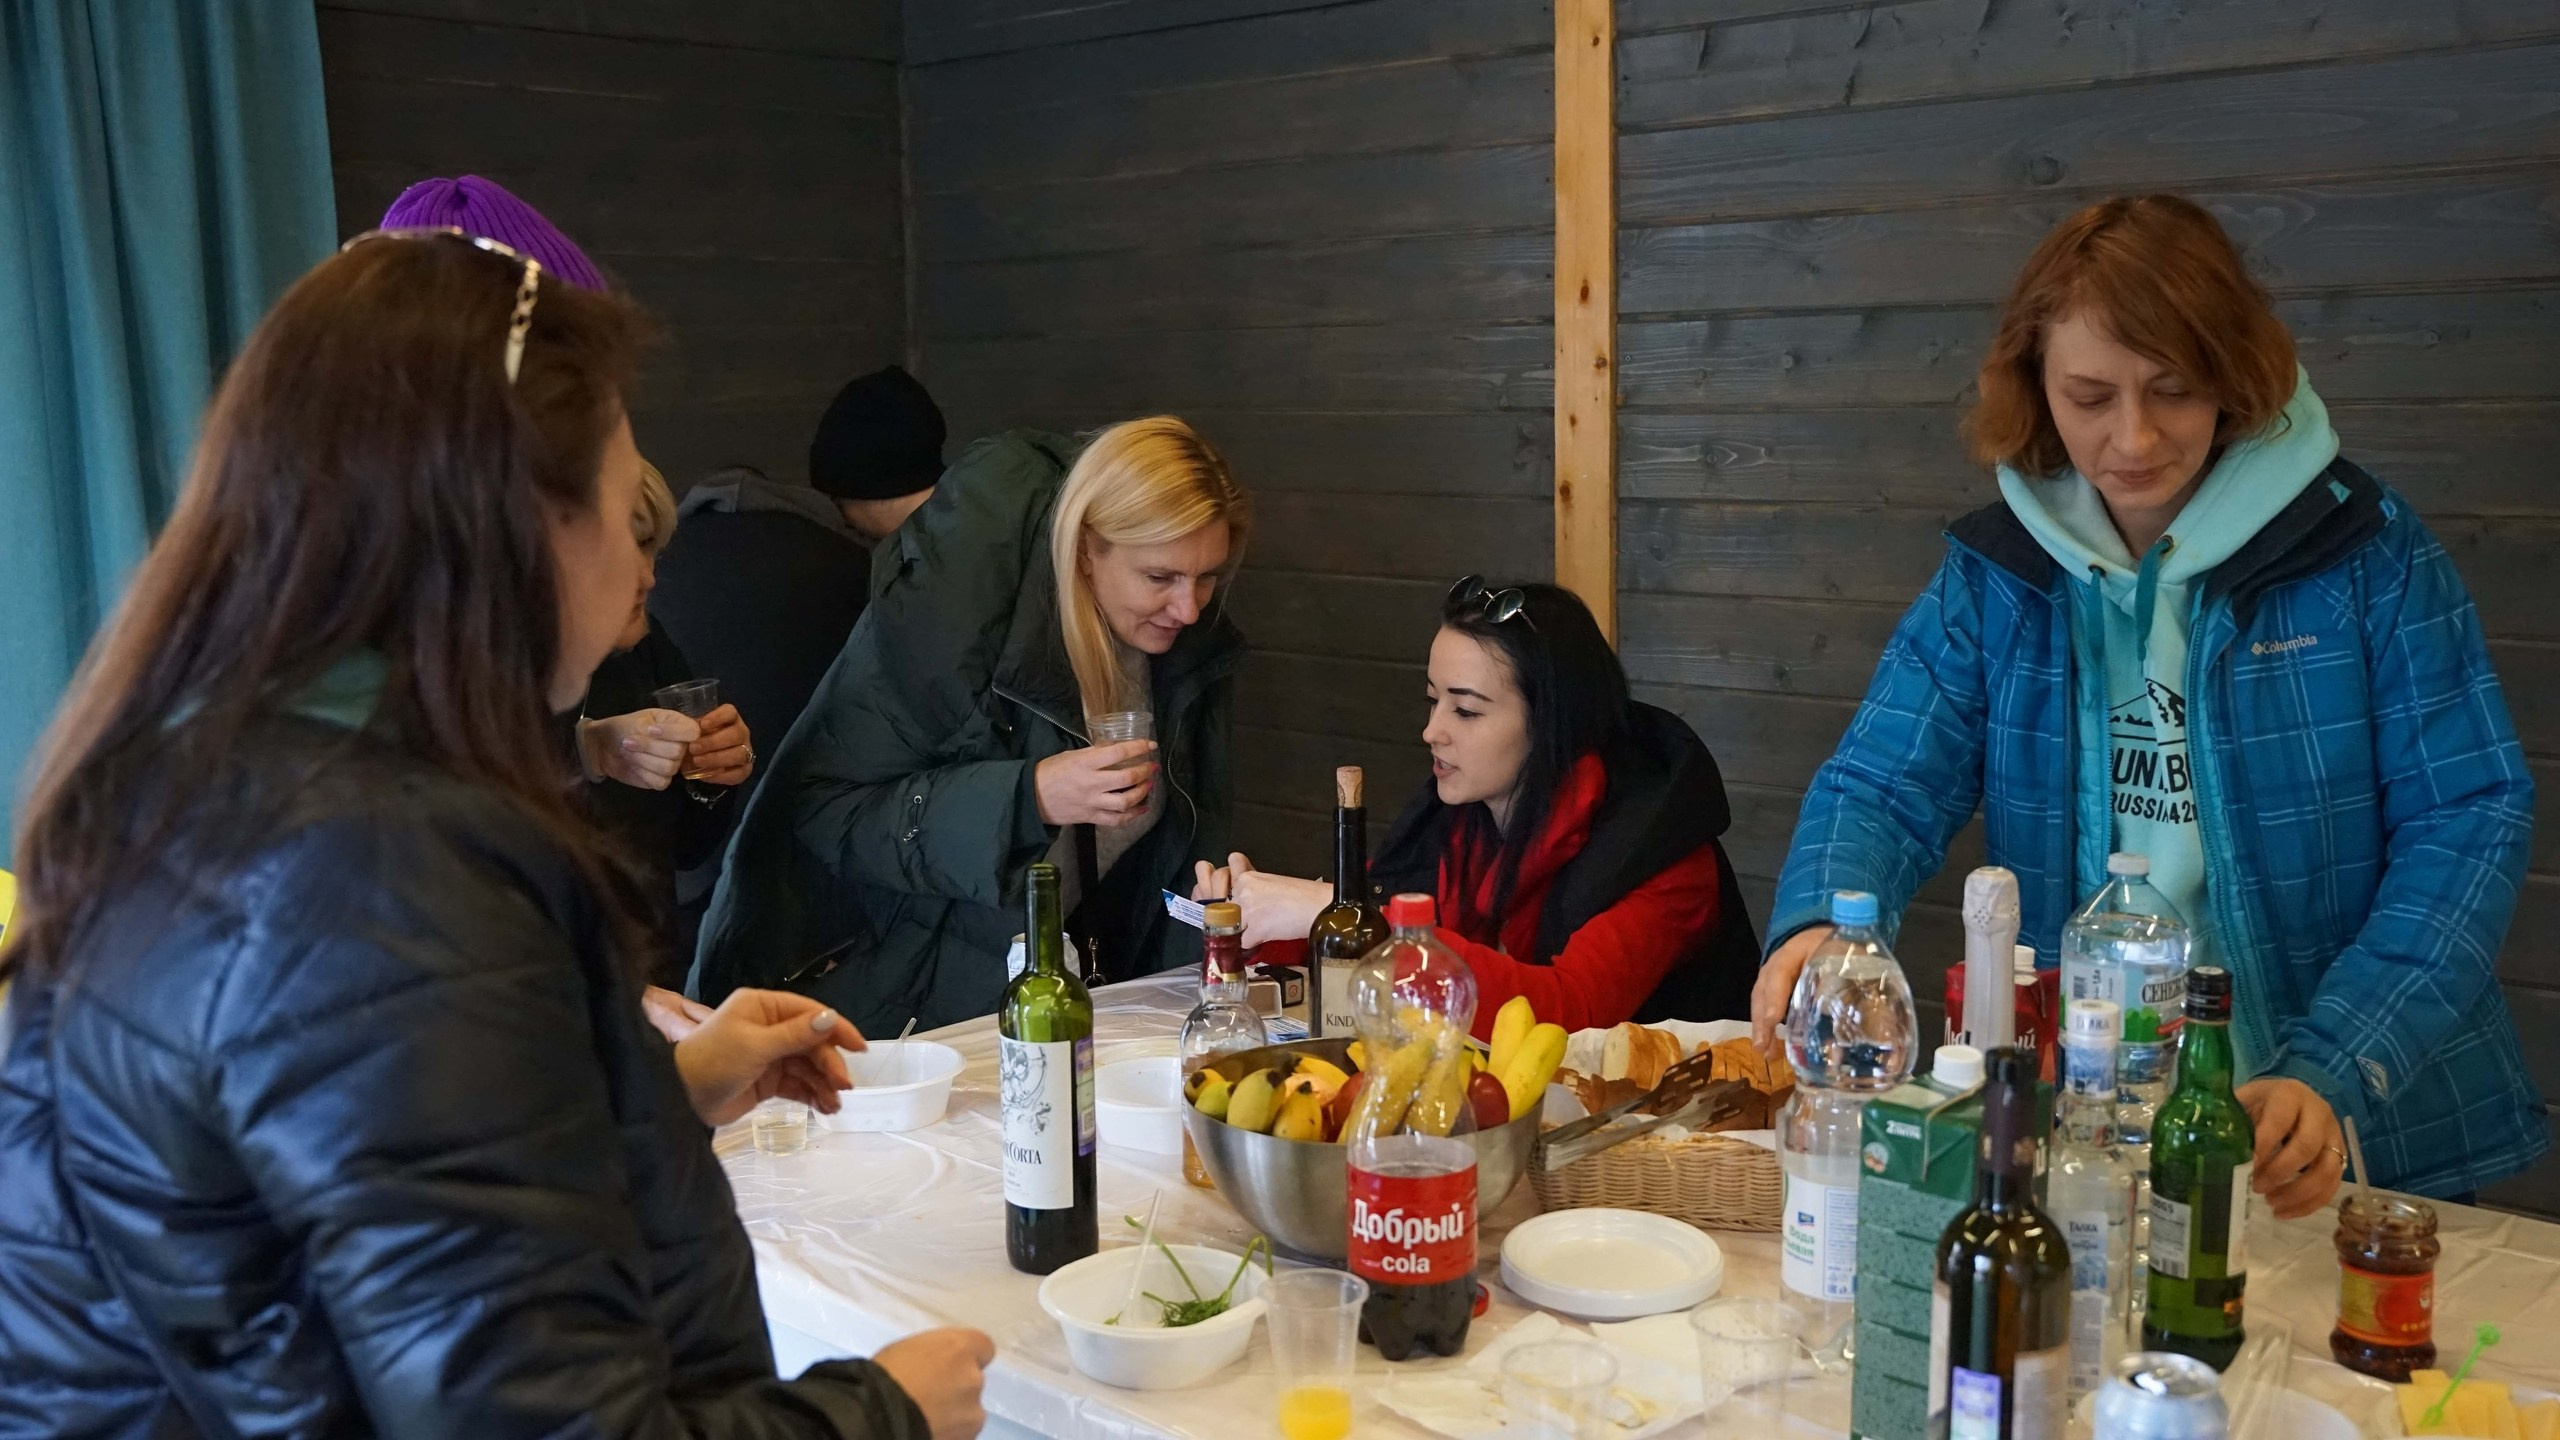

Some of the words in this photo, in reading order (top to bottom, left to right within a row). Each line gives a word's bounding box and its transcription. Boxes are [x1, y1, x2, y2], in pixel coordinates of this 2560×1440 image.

[2262, 635, 2318, 654] Columbia
[1010, 1141, 1042, 1165] CORTA
[1352, 1198, 1465, 1250] Добрый
[1381, 1252, 1430, 1274] cola
